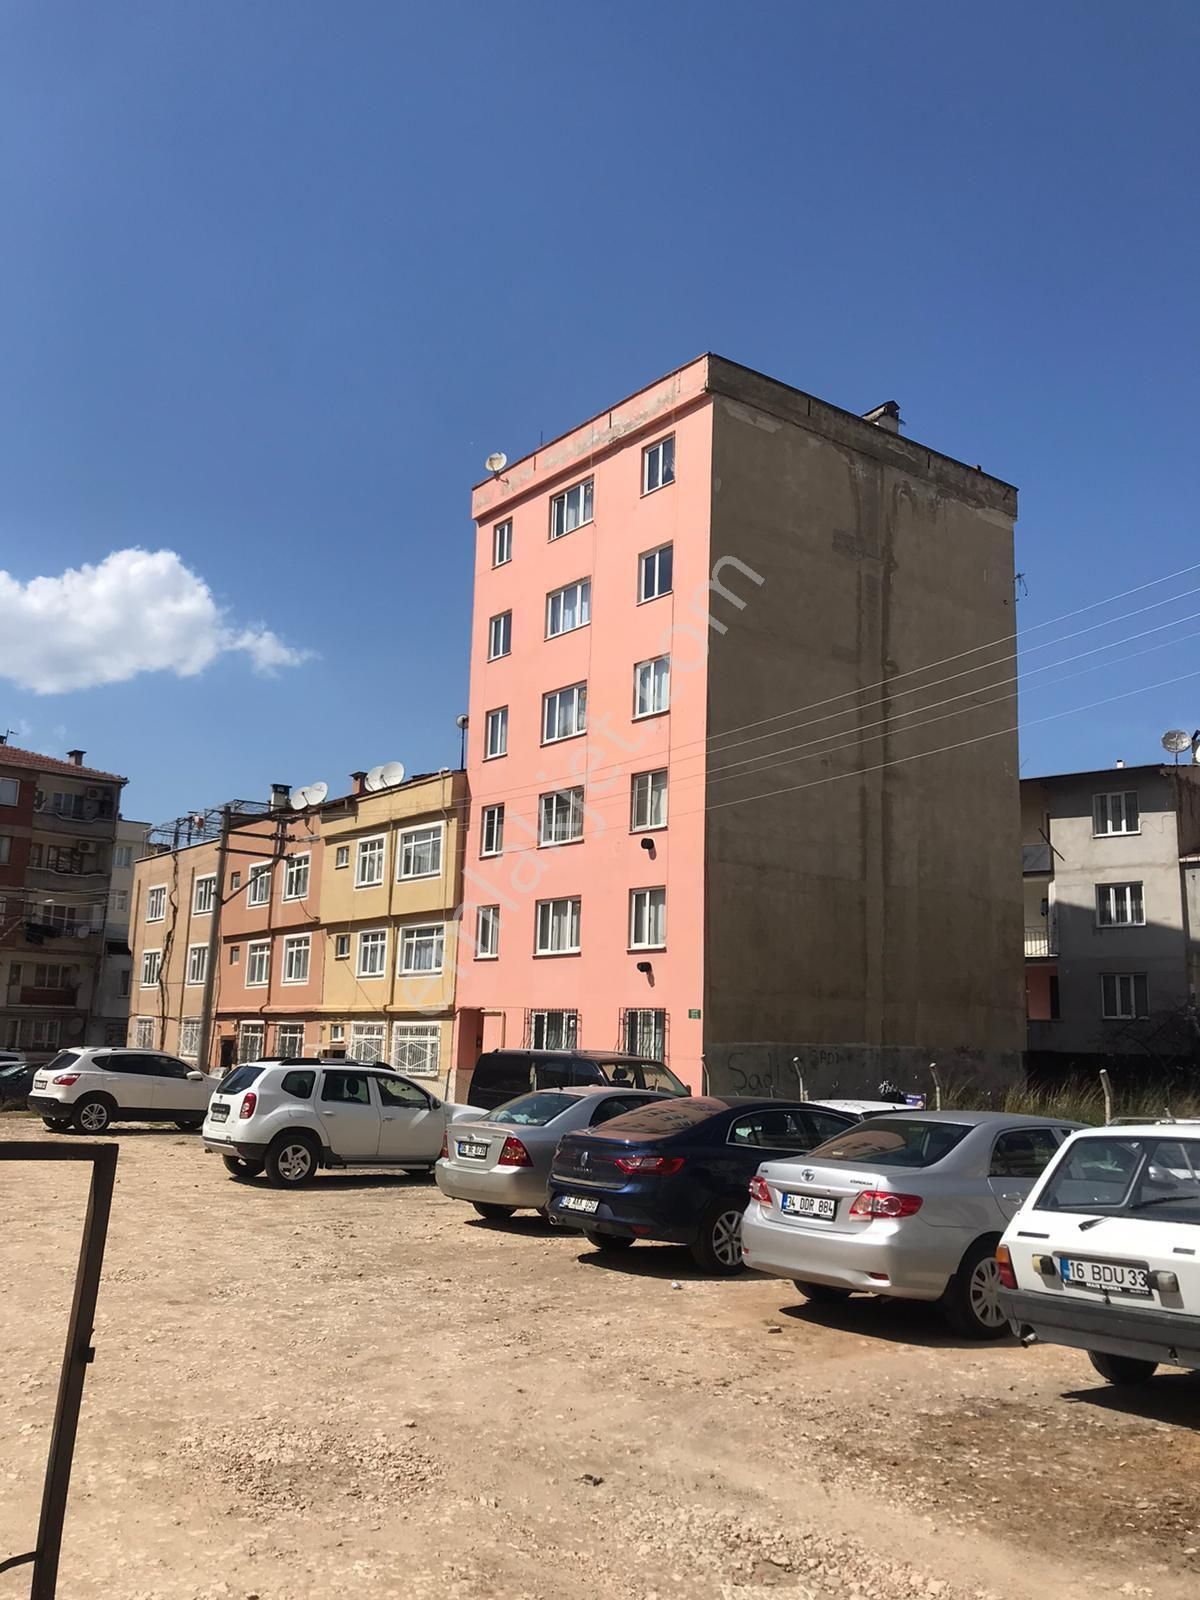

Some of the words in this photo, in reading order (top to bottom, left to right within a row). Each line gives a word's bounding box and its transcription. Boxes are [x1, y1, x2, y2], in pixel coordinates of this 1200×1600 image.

[786, 1195, 795, 1208] 34
[818, 1198, 833, 1213] 884
[1070, 1262, 1085, 1279] 16
[1091, 1264, 1125, 1284] BDU
[1127, 1269, 1147, 1287] 33
